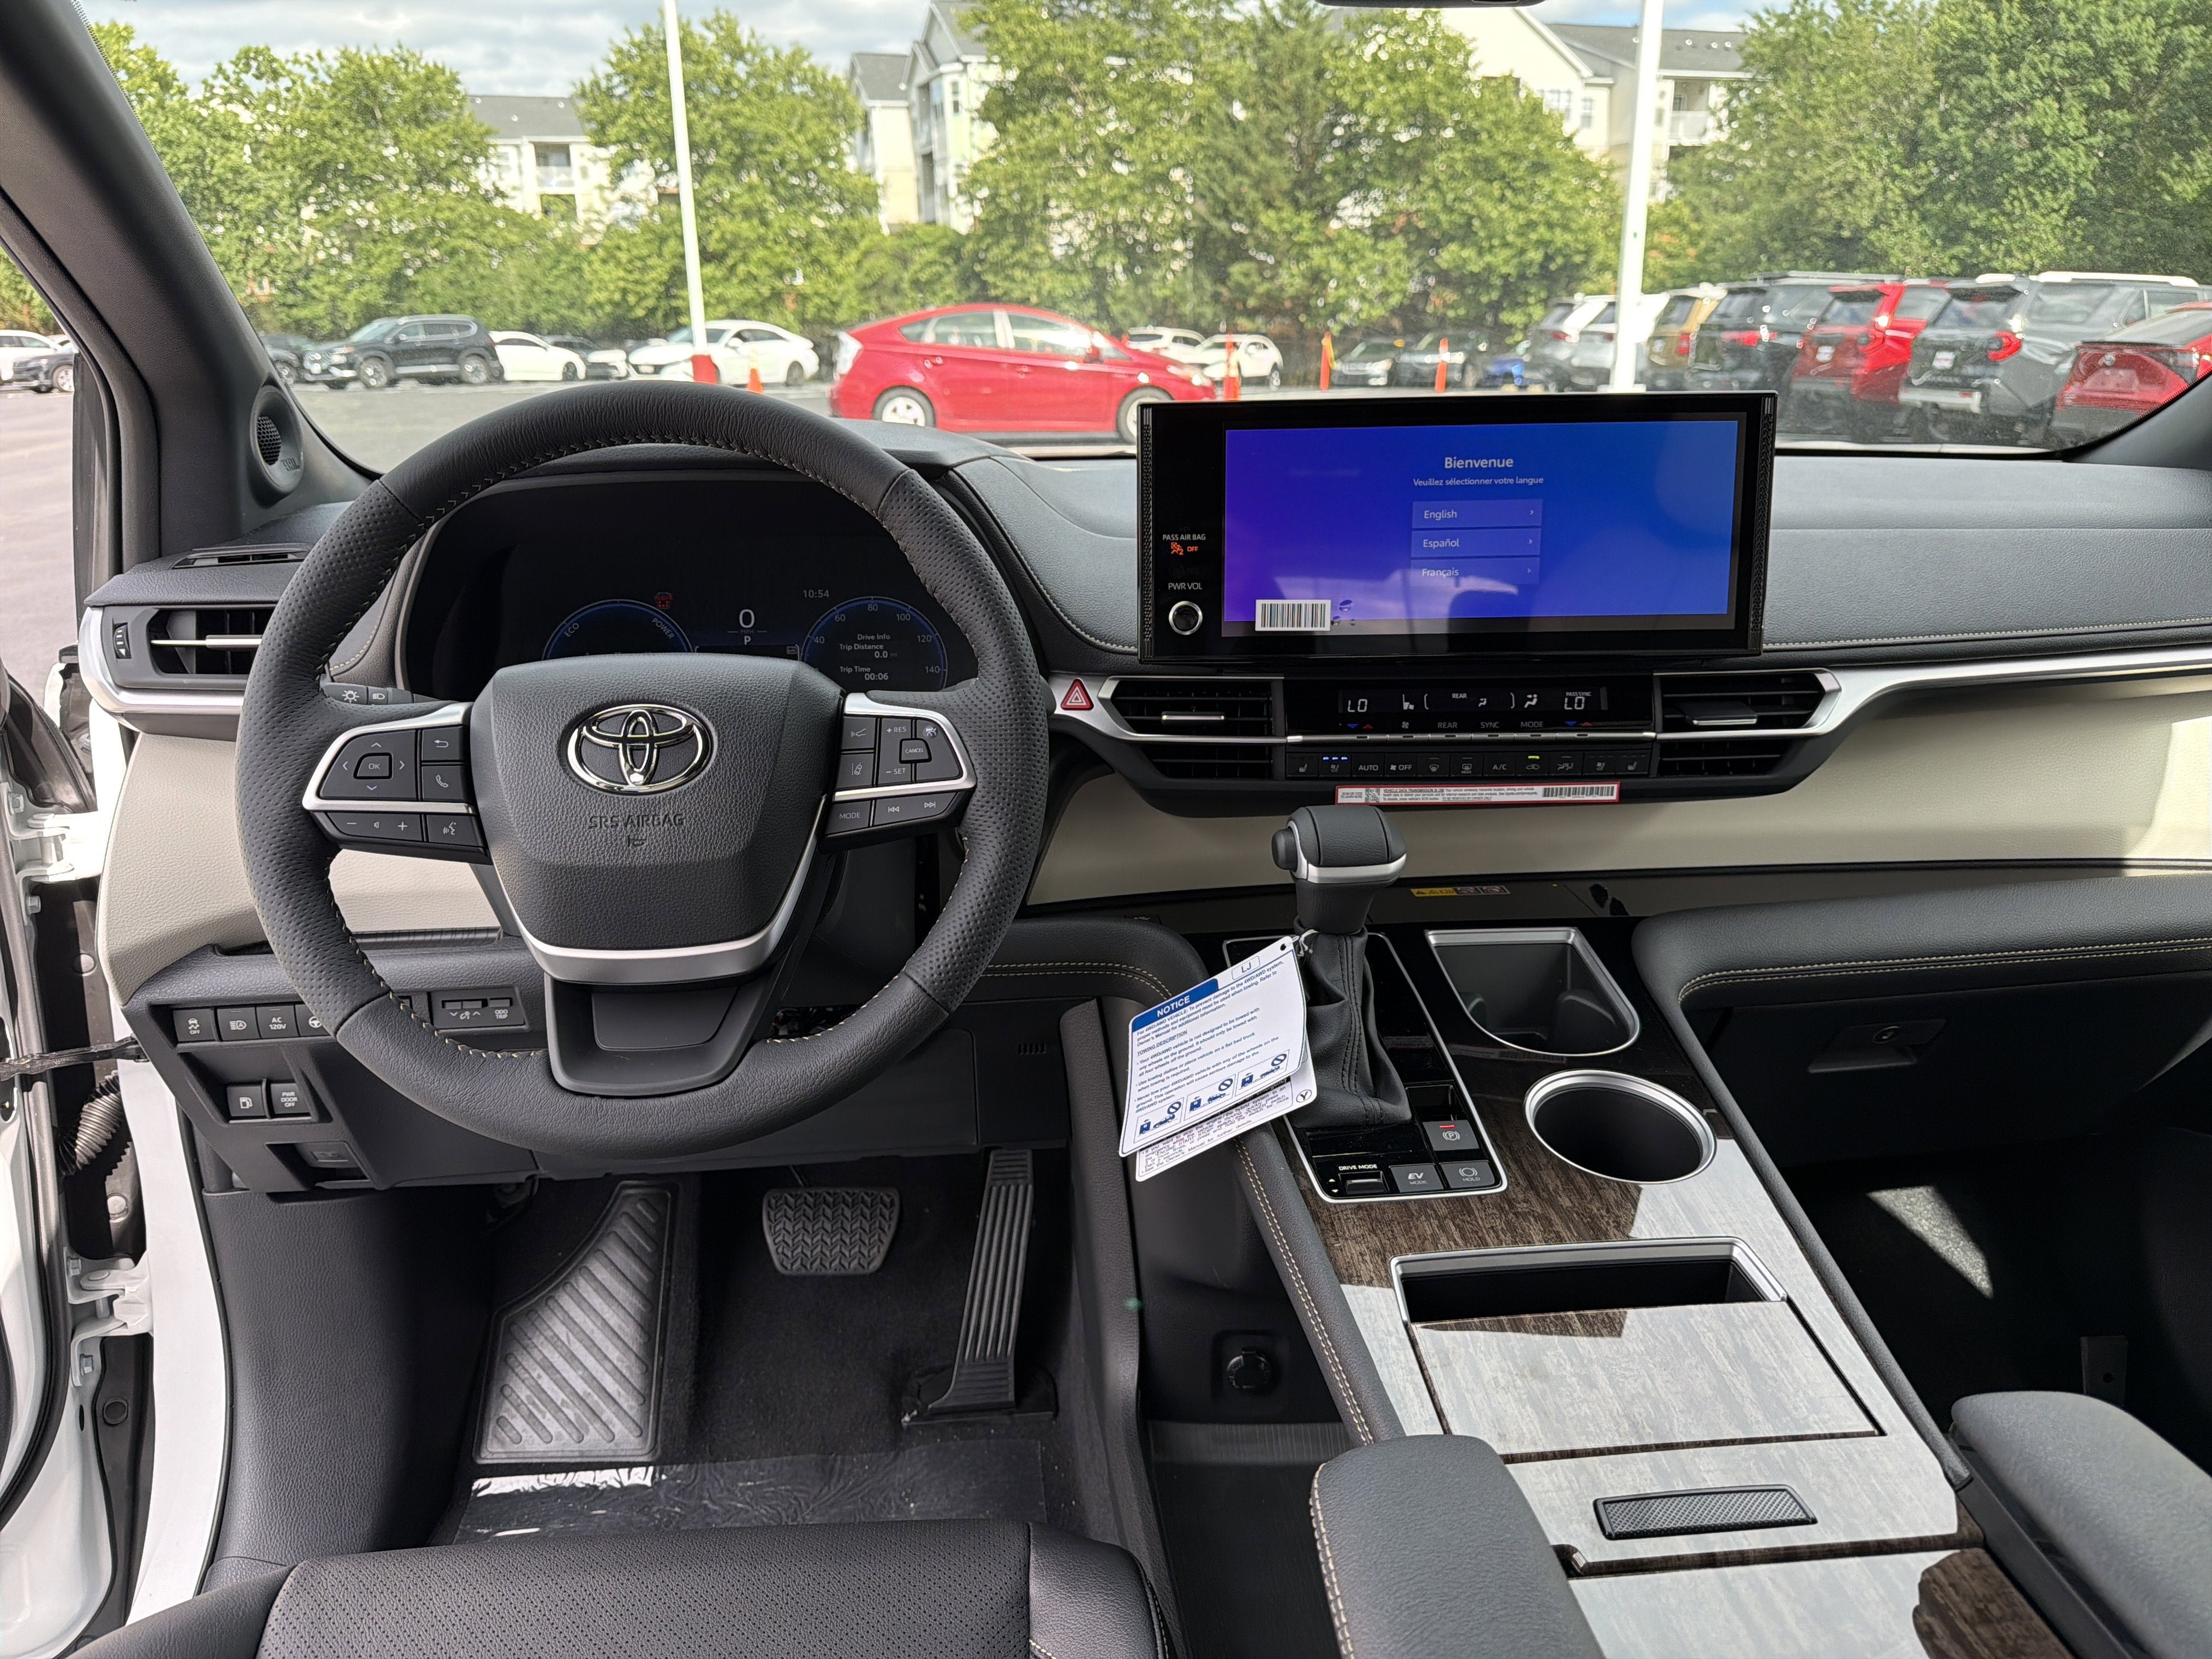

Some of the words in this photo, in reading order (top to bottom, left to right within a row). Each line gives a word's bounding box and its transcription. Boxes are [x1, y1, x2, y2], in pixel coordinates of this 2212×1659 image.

[1444, 455, 1514, 470] Bienvenue
[1413, 477, 1445, 487] Veuillez
[1446, 476, 1492, 487] sélectionner
[1494, 477, 1514, 486] votre
[1515, 476, 1544, 487] langue
[1423, 508, 1458, 522] English
[1422, 537, 1460, 551] Español
[1421, 566, 1459, 580] Français
[1168, 582, 1186, 590] PWR
[1187, 582, 1203, 590] VOL
[803, 589, 830, 599] 10:54
[739, 609, 755, 628] 0
[834, 613, 846, 622] 60
[896, 613, 911, 621] 100
[563, 623, 580, 638] ECO
[652, 617, 675, 640] POWER
[744, 636, 751, 646] P
[814, 636, 825, 644] 40
[917, 635, 932, 643] 120
[839, 644, 853, 652] Trip
[925, 665, 940, 674] 140
[1347, 698, 1368, 713] LO
[1564, 696, 1585, 710] LO
[589, 815, 620, 829] SRS
[625, 812, 686, 828] AIRBAG
[839, 812, 861, 820] MODE
[1241, 962, 1252, 973] LJ
[1157, 995, 1191, 1017] NOTICE
[1137, 1036, 1154, 1046] Owner's
[1155, 1028, 1170, 1038] Manual
[1137, 1044, 1155, 1056] TOWING
